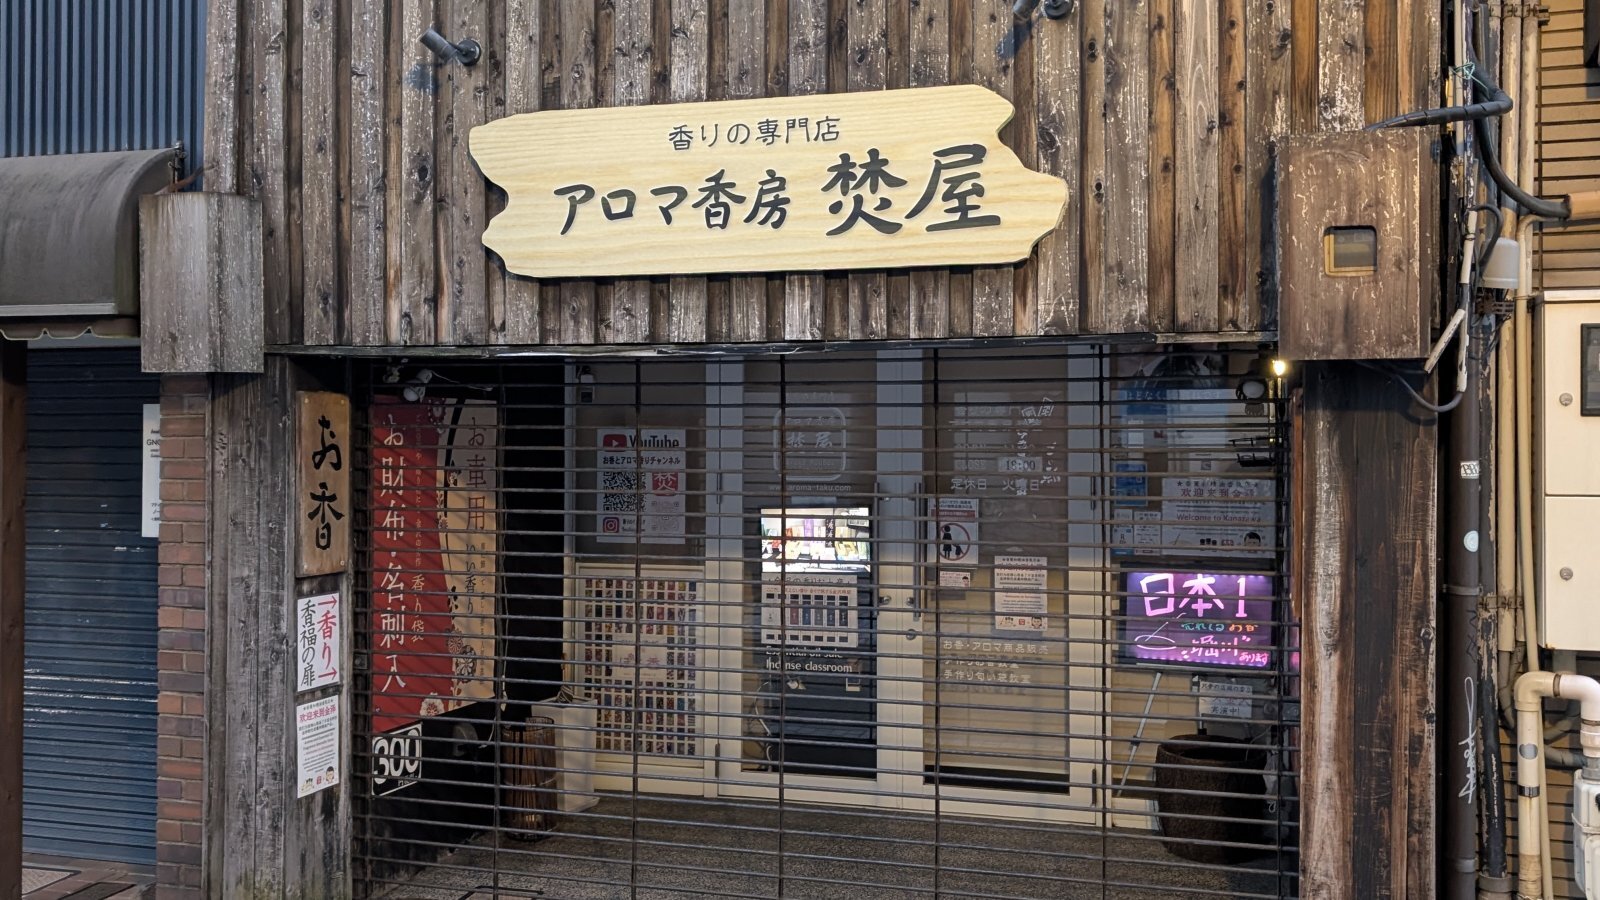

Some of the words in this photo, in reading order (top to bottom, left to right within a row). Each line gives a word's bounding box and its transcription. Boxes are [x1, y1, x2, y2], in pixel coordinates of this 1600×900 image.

[668, 115, 841, 151] 香りの専門店
[553, 168, 792, 236] アロマ香房
[821, 143, 1001, 237] 焚屋
[307, 415, 345, 550] お香
[466, 416, 487, 530] お車用
[950, 478, 987, 490] 定休日
[1139, 573, 1248, 618] 日本1
[317, 609, 337, 670] 香り
[766, 658, 802, 670] Incnse
[805, 660, 853, 673] classroom
[373, 729, 420, 785] 300
